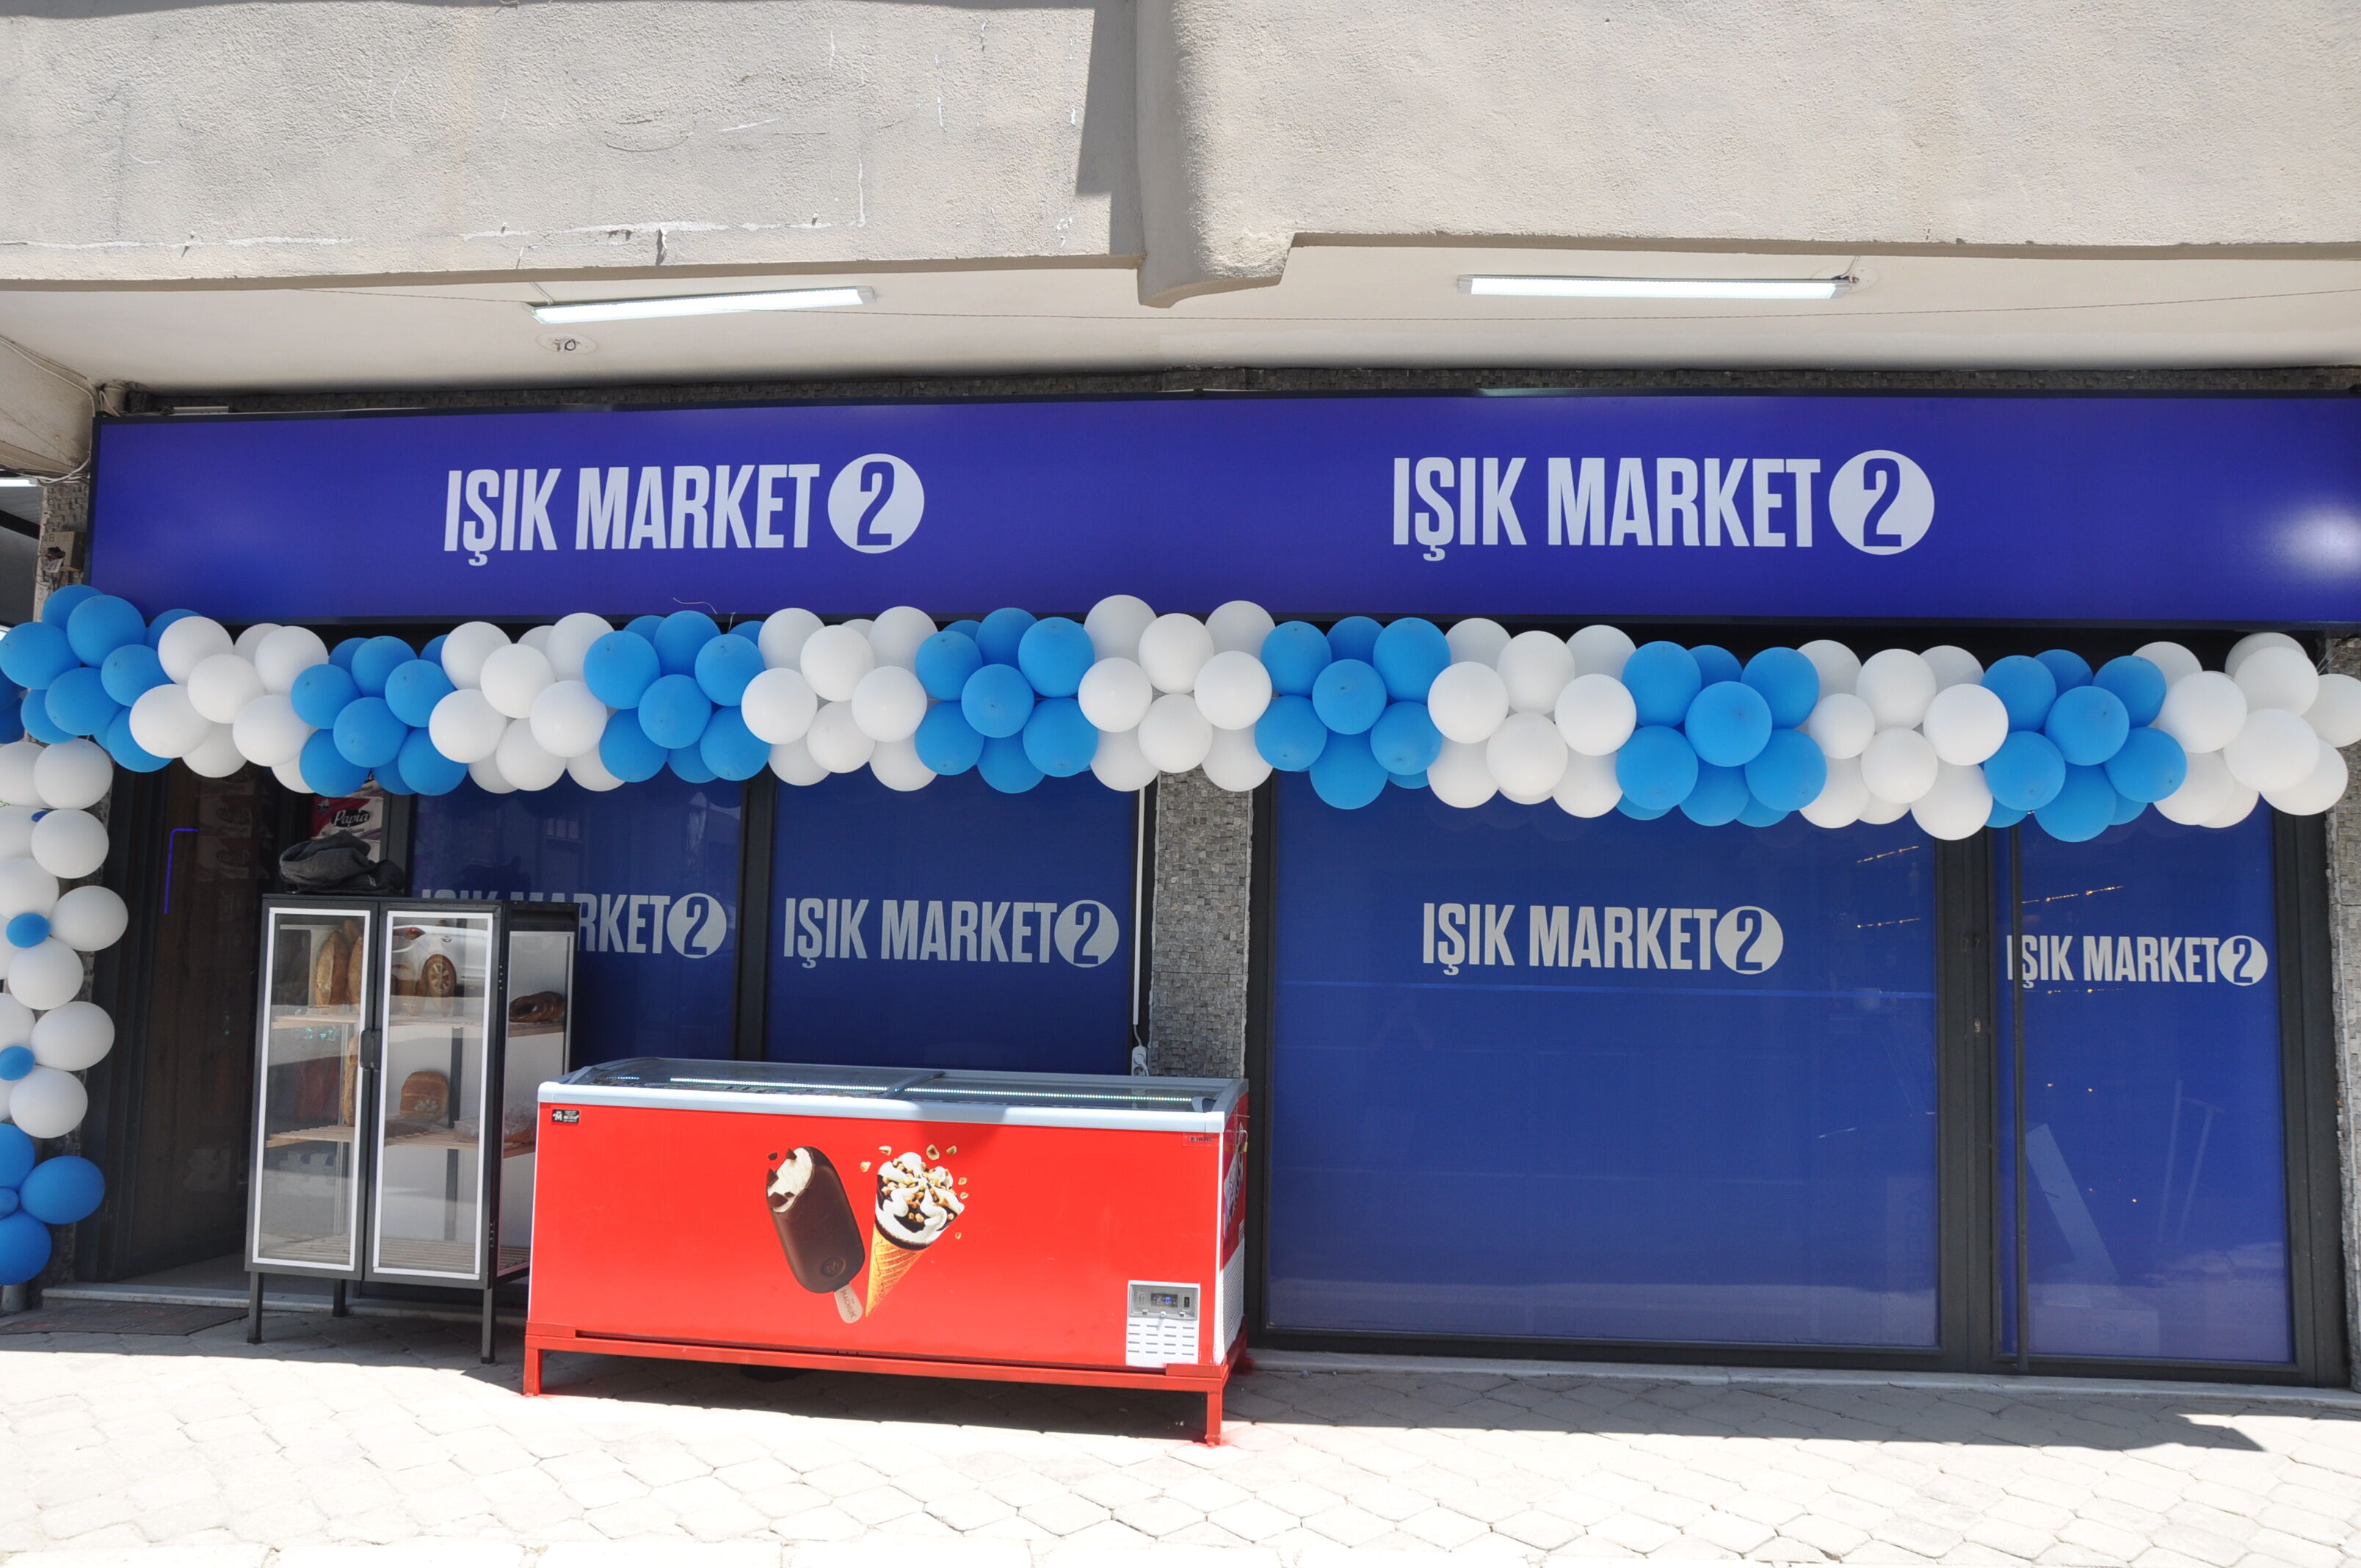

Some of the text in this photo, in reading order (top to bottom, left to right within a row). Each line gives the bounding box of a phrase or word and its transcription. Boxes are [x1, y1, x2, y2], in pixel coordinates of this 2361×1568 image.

[443, 468, 562, 566] IŞIK
[575, 464, 820, 551] MARKET
[1393, 457, 1527, 561] IŞIK
[1548, 457, 1821, 547] MARKET
[333, 808, 369, 828] Papia
[511, 892, 671, 954] RKET
[783, 898, 870, 969] IŞIK
[880, 899, 1058, 963] MARKET
[1423, 902, 1515, 976] IŞIK
[1529, 905, 1717, 970] MARKET
[2006, 934, 2075, 989] IŞIK
[2083, 936, 2219, 983] MARKET
